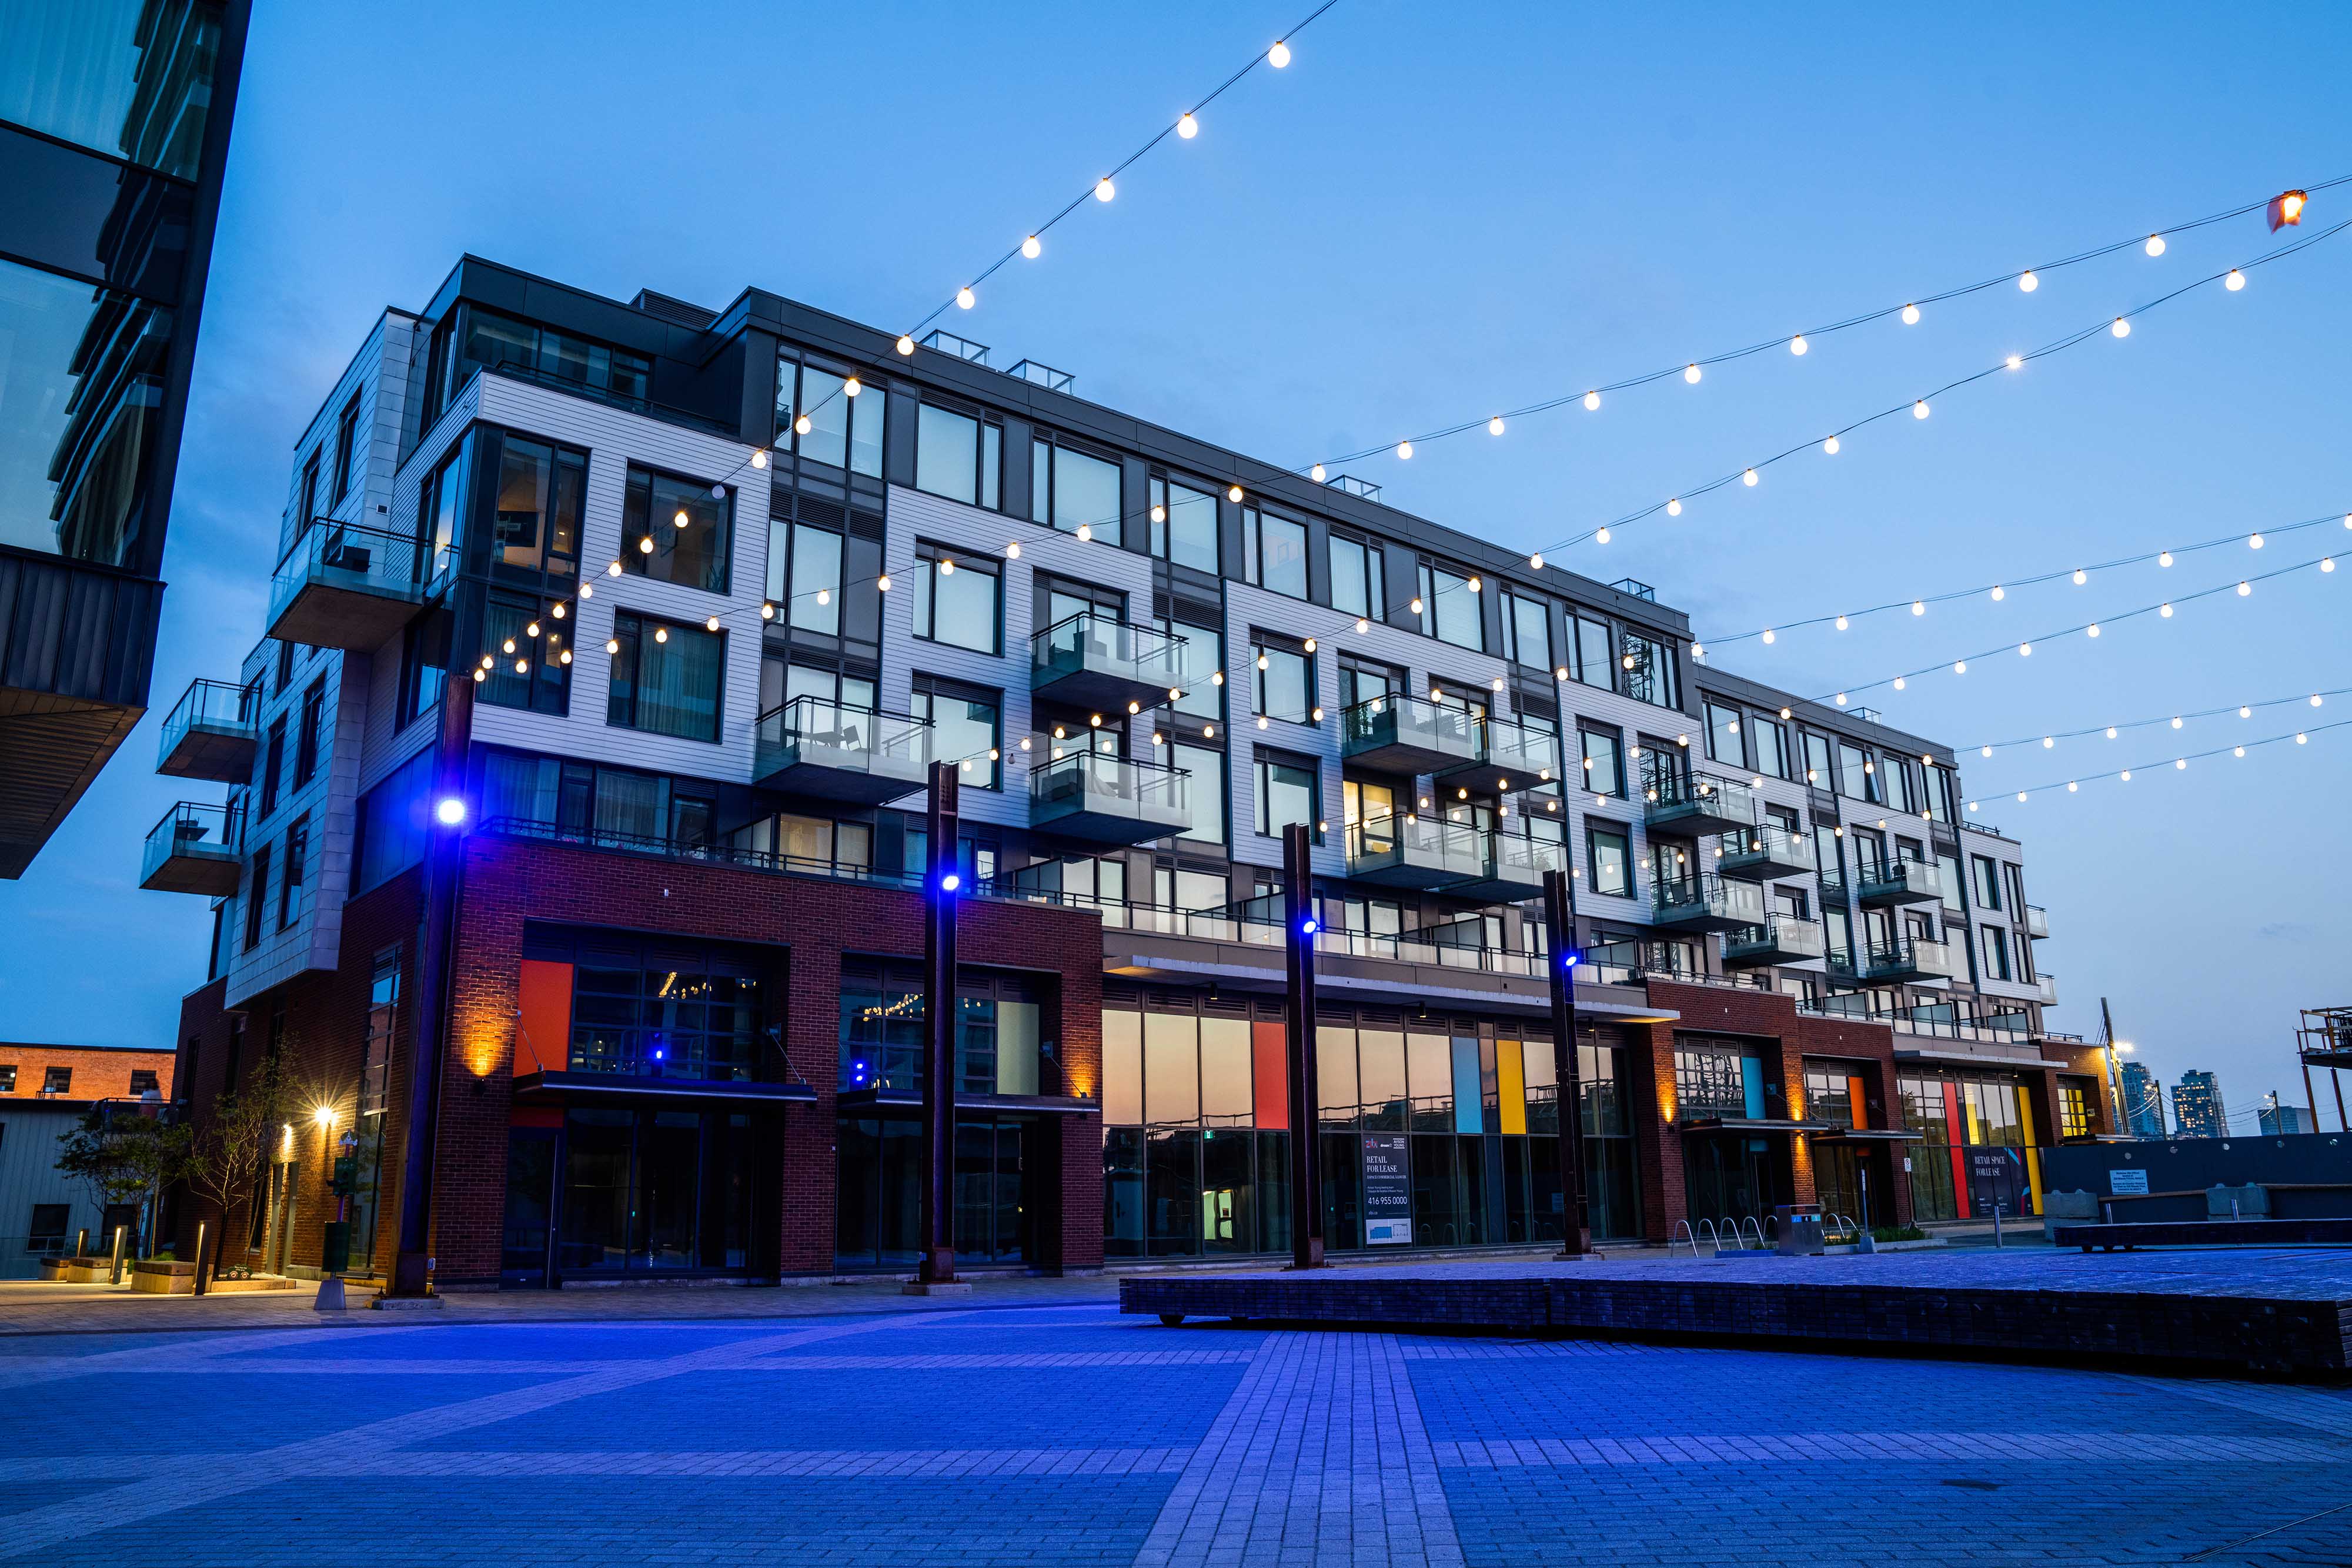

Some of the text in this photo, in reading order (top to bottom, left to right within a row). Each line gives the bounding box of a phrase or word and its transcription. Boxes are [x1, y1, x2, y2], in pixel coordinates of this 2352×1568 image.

[1975, 1156, 2006, 1164] RETAIL SPACE
[1976, 1168, 2000, 1176] FOR LEASE
